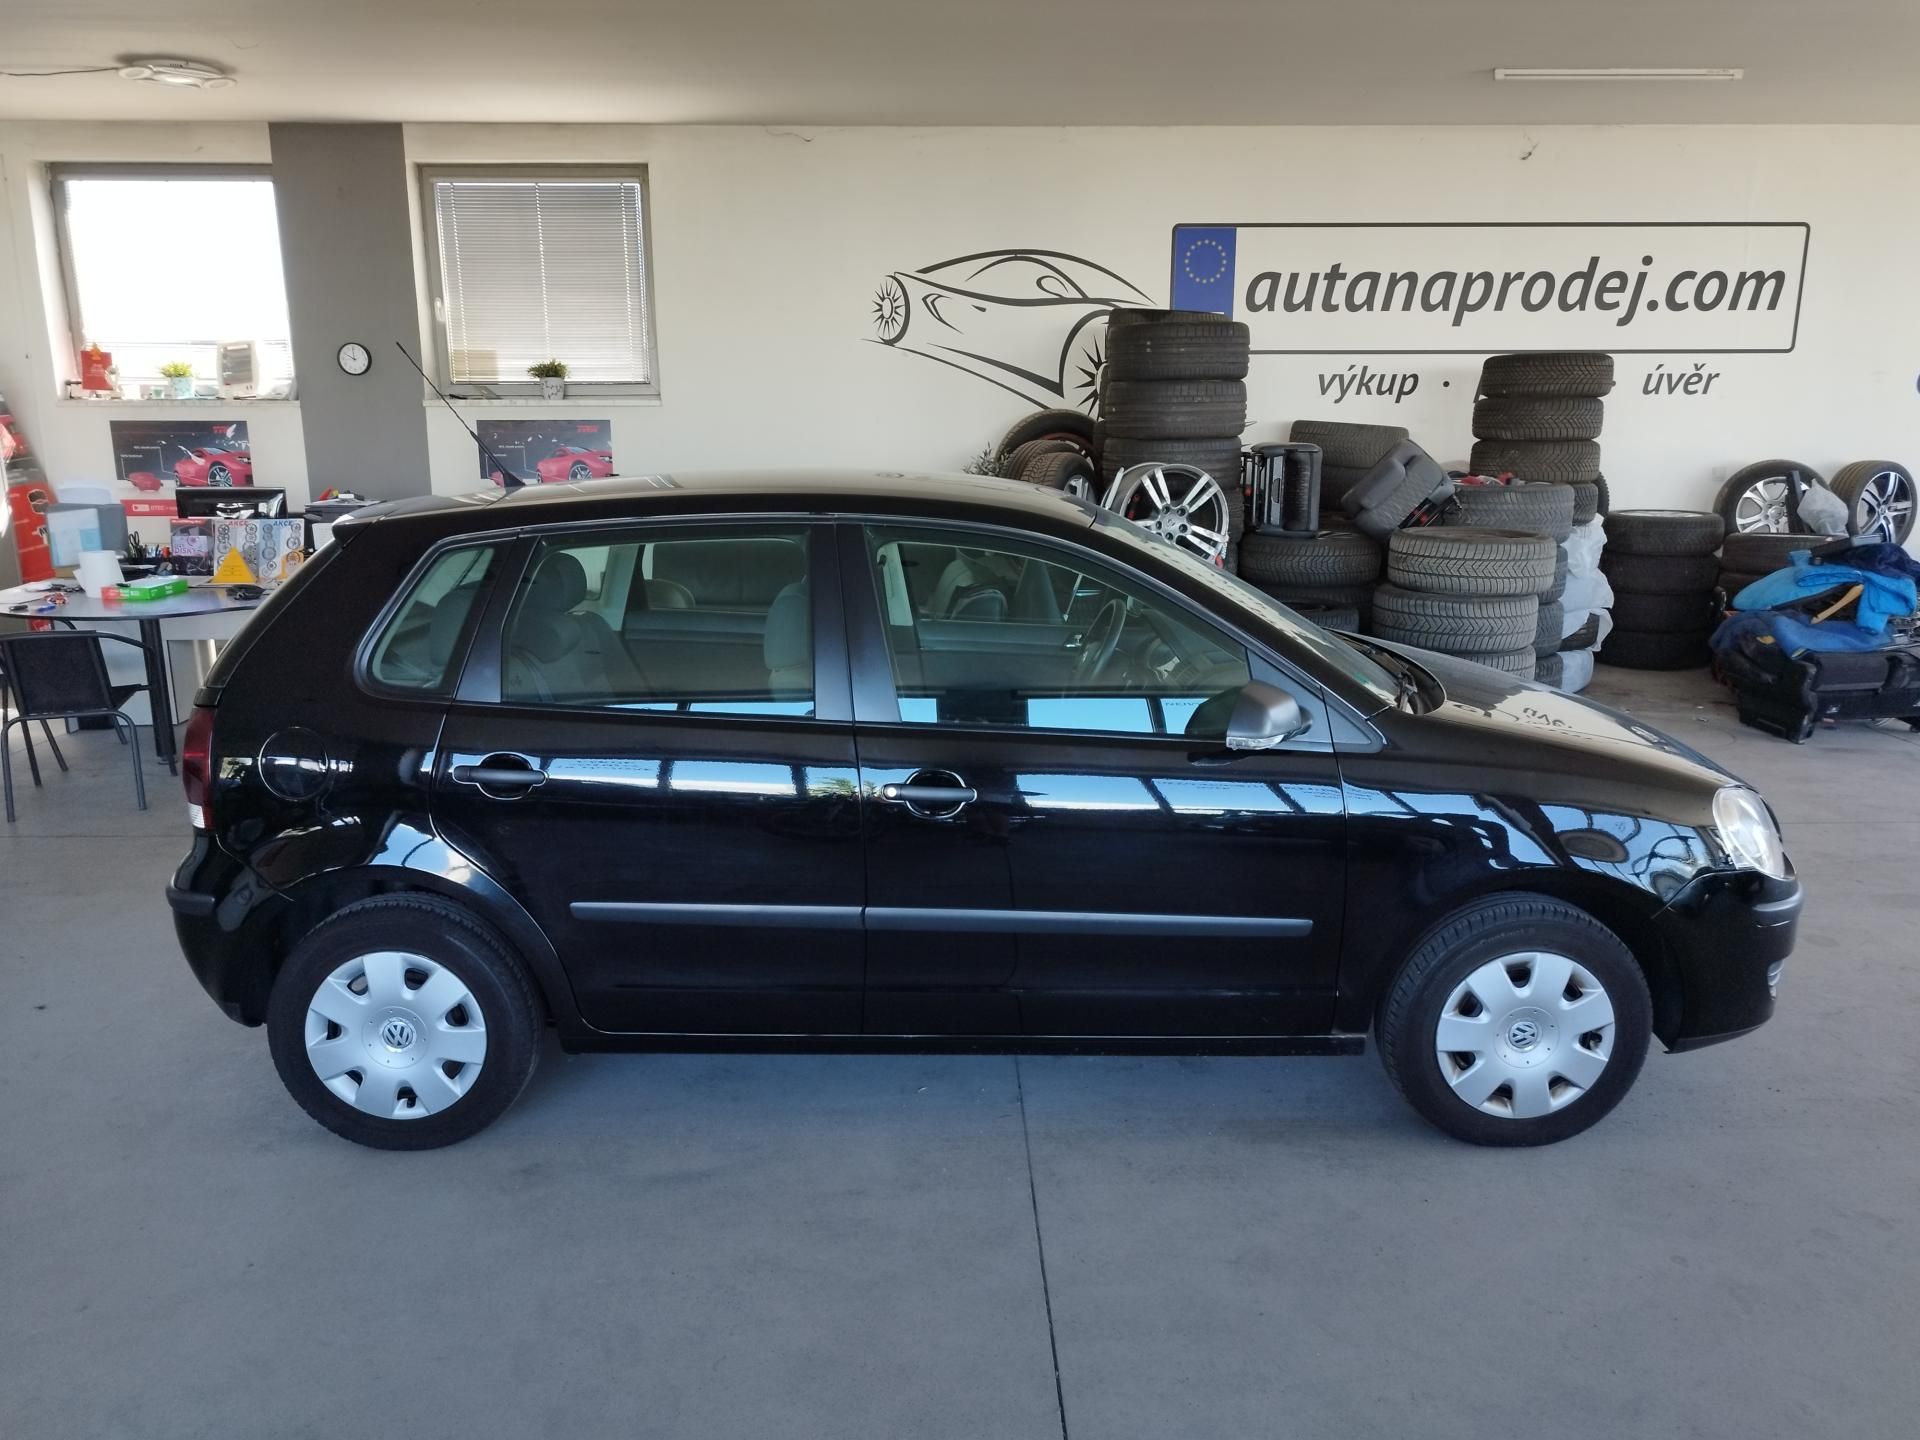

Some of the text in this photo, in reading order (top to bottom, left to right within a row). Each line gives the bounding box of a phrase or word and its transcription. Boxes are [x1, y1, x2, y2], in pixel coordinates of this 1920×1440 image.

[1246, 256, 1784, 326] autanaprodej.com
[1318, 363, 1721, 404] výkup úvěr
